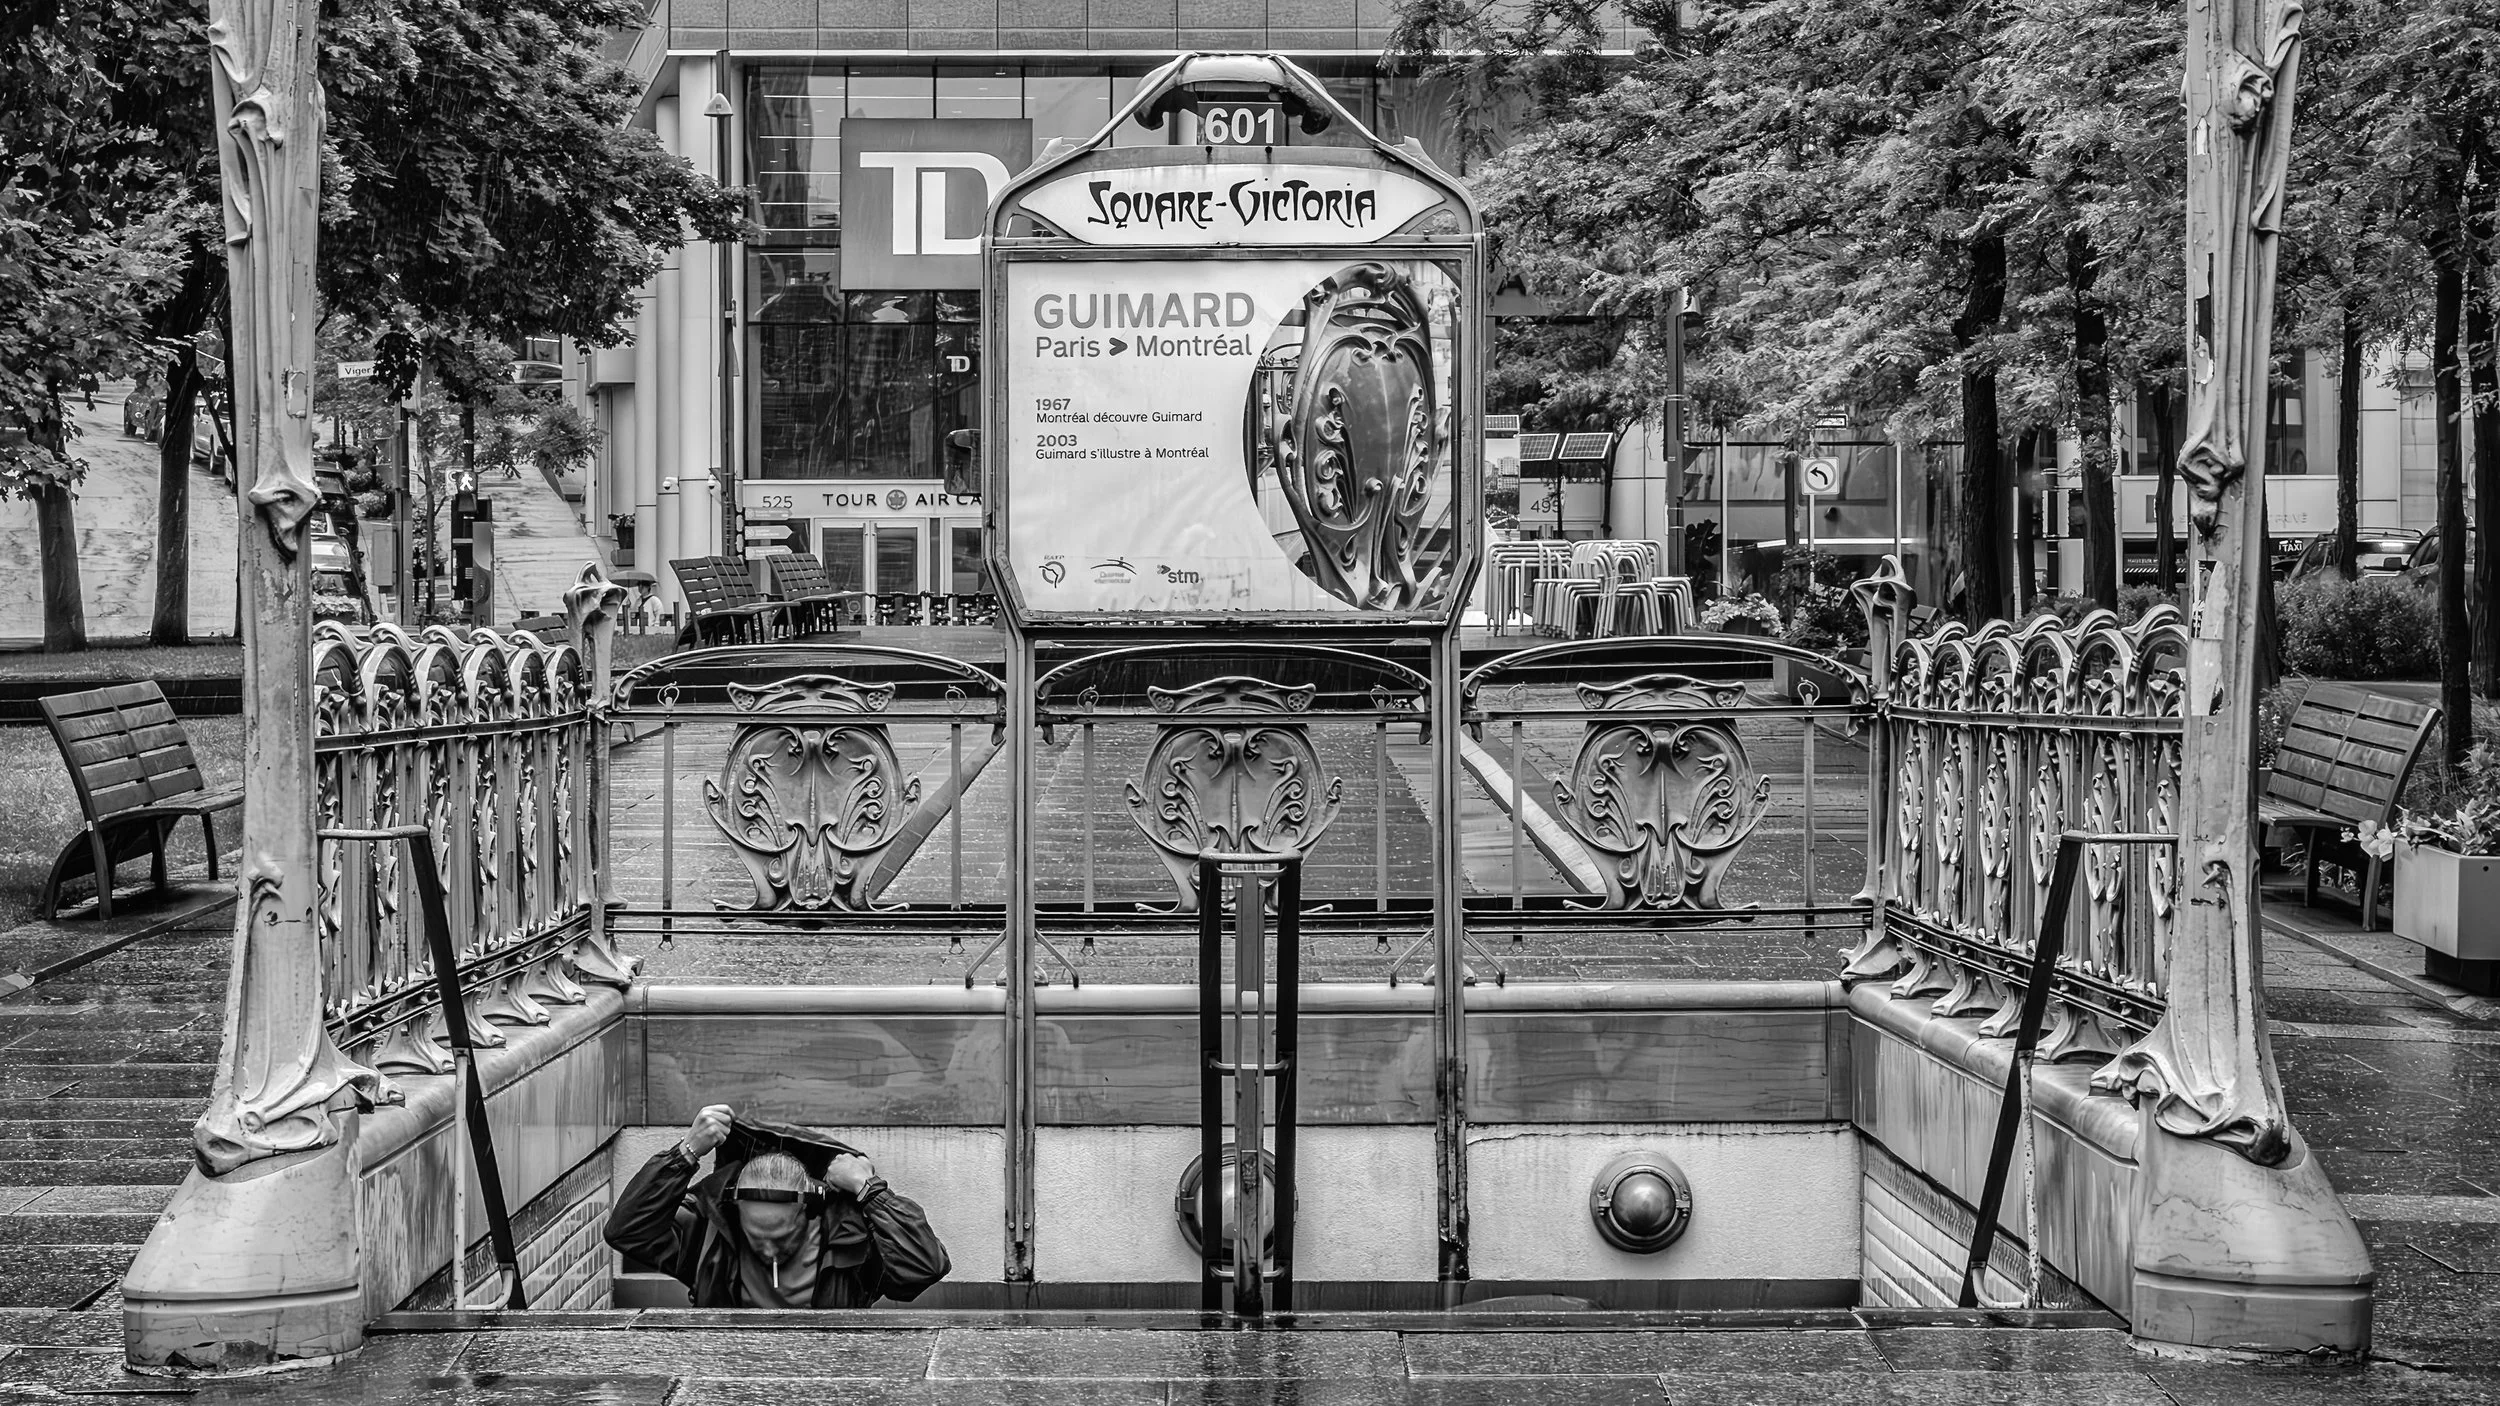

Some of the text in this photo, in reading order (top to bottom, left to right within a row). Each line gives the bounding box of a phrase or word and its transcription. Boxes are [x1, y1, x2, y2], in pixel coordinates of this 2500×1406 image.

[1205, 107, 1275, 144] 601
[860, 152, 1011, 255] TD
[1034, 292, 1255, 329] GUIMARD
[1036, 333, 1253, 358] Paris Montréal
[946, 355, 970, 372] TD
[344, 367, 371, 376] Viger
[1035, 398, 1072, 411] 1967
[1036, 411, 1203, 423] Montréal découvre Guimard
[1036, 434, 1078, 447] 2003
[1035, 447, 1210, 460] Guimard s'illustre à Montréal
[762, 495, 793, 508] 525
[822, 493, 878, 507] TOUR
[915, 493, 950, 506] AIR
[2282, 543, 2302, 552] TAXI
[1168, 569, 1199, 584] stm
